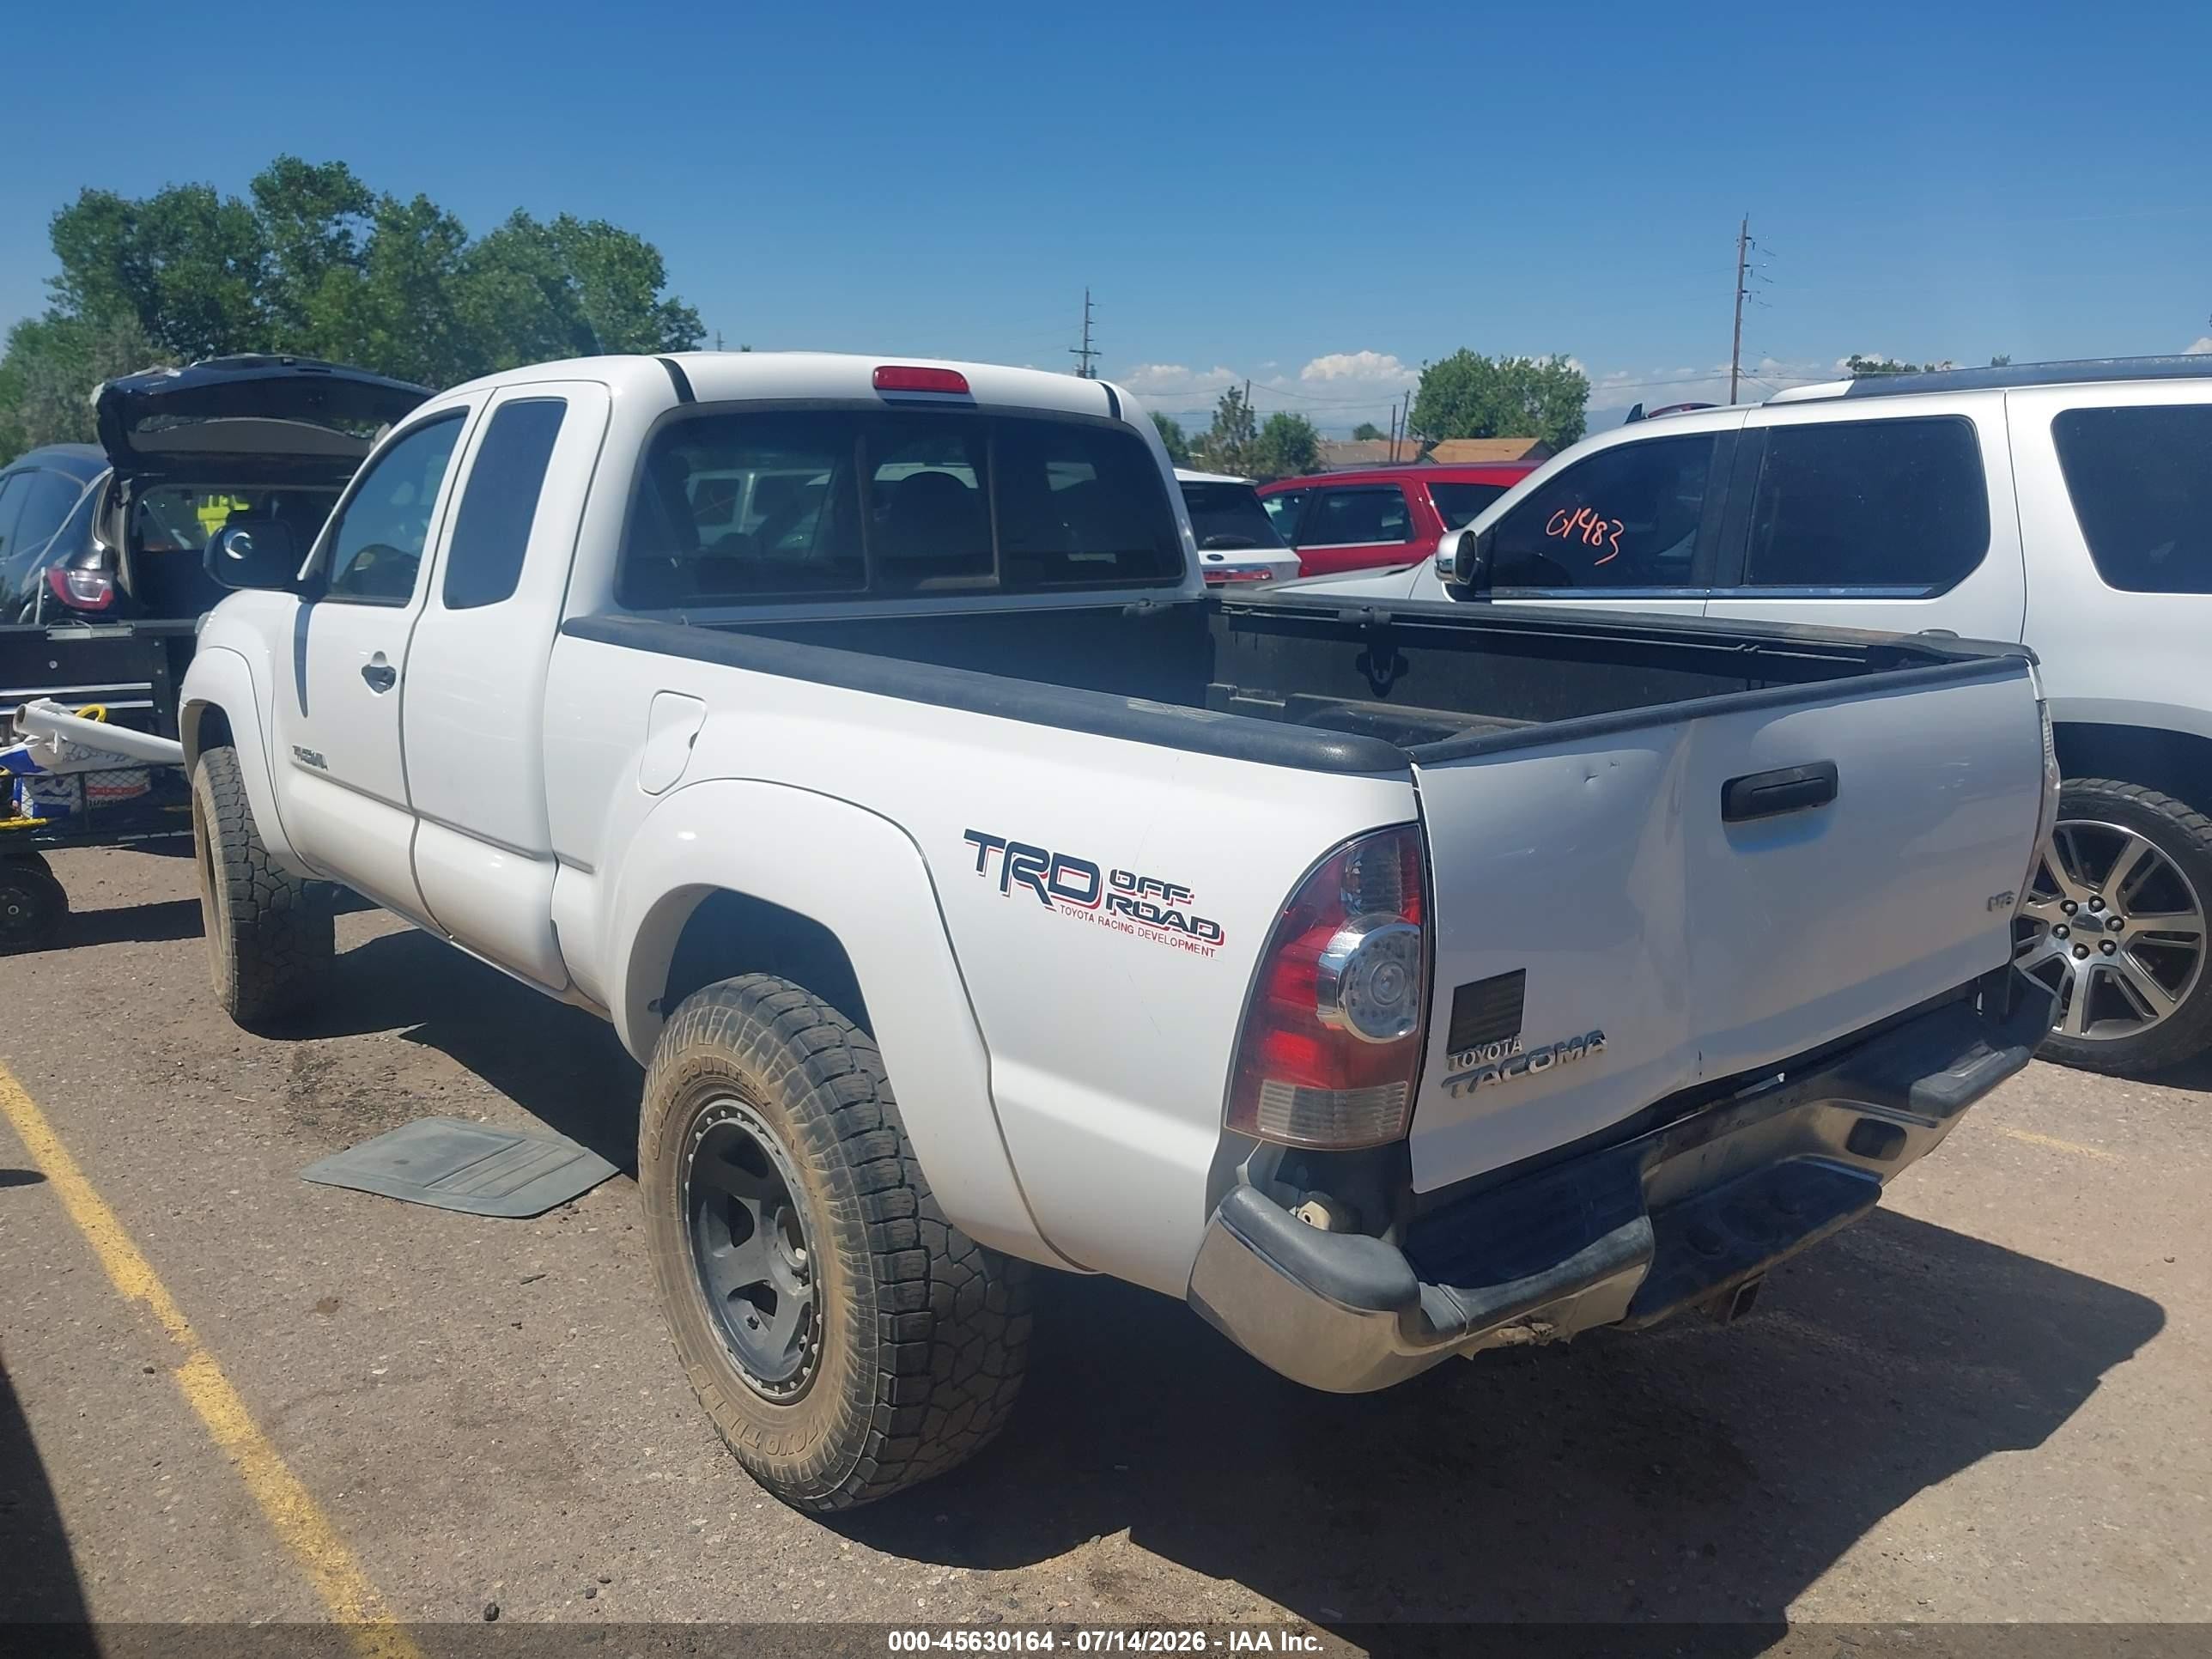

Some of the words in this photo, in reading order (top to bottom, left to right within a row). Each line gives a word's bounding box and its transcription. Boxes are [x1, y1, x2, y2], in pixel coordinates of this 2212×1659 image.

[963, 828, 1103, 911] TRD
[1108, 868, 1194, 906] OFF
[1060, 903, 1095, 924] TOYOTA
[1097, 915, 1134, 935] RACING
[1137, 927, 1217, 958] DEVELOPMENT
[1105, 892, 1224, 946] ROAD
[1441, 1030, 1608, 1099] TACOMA
[1448, 1036, 1524, 1071] TOYOTA
